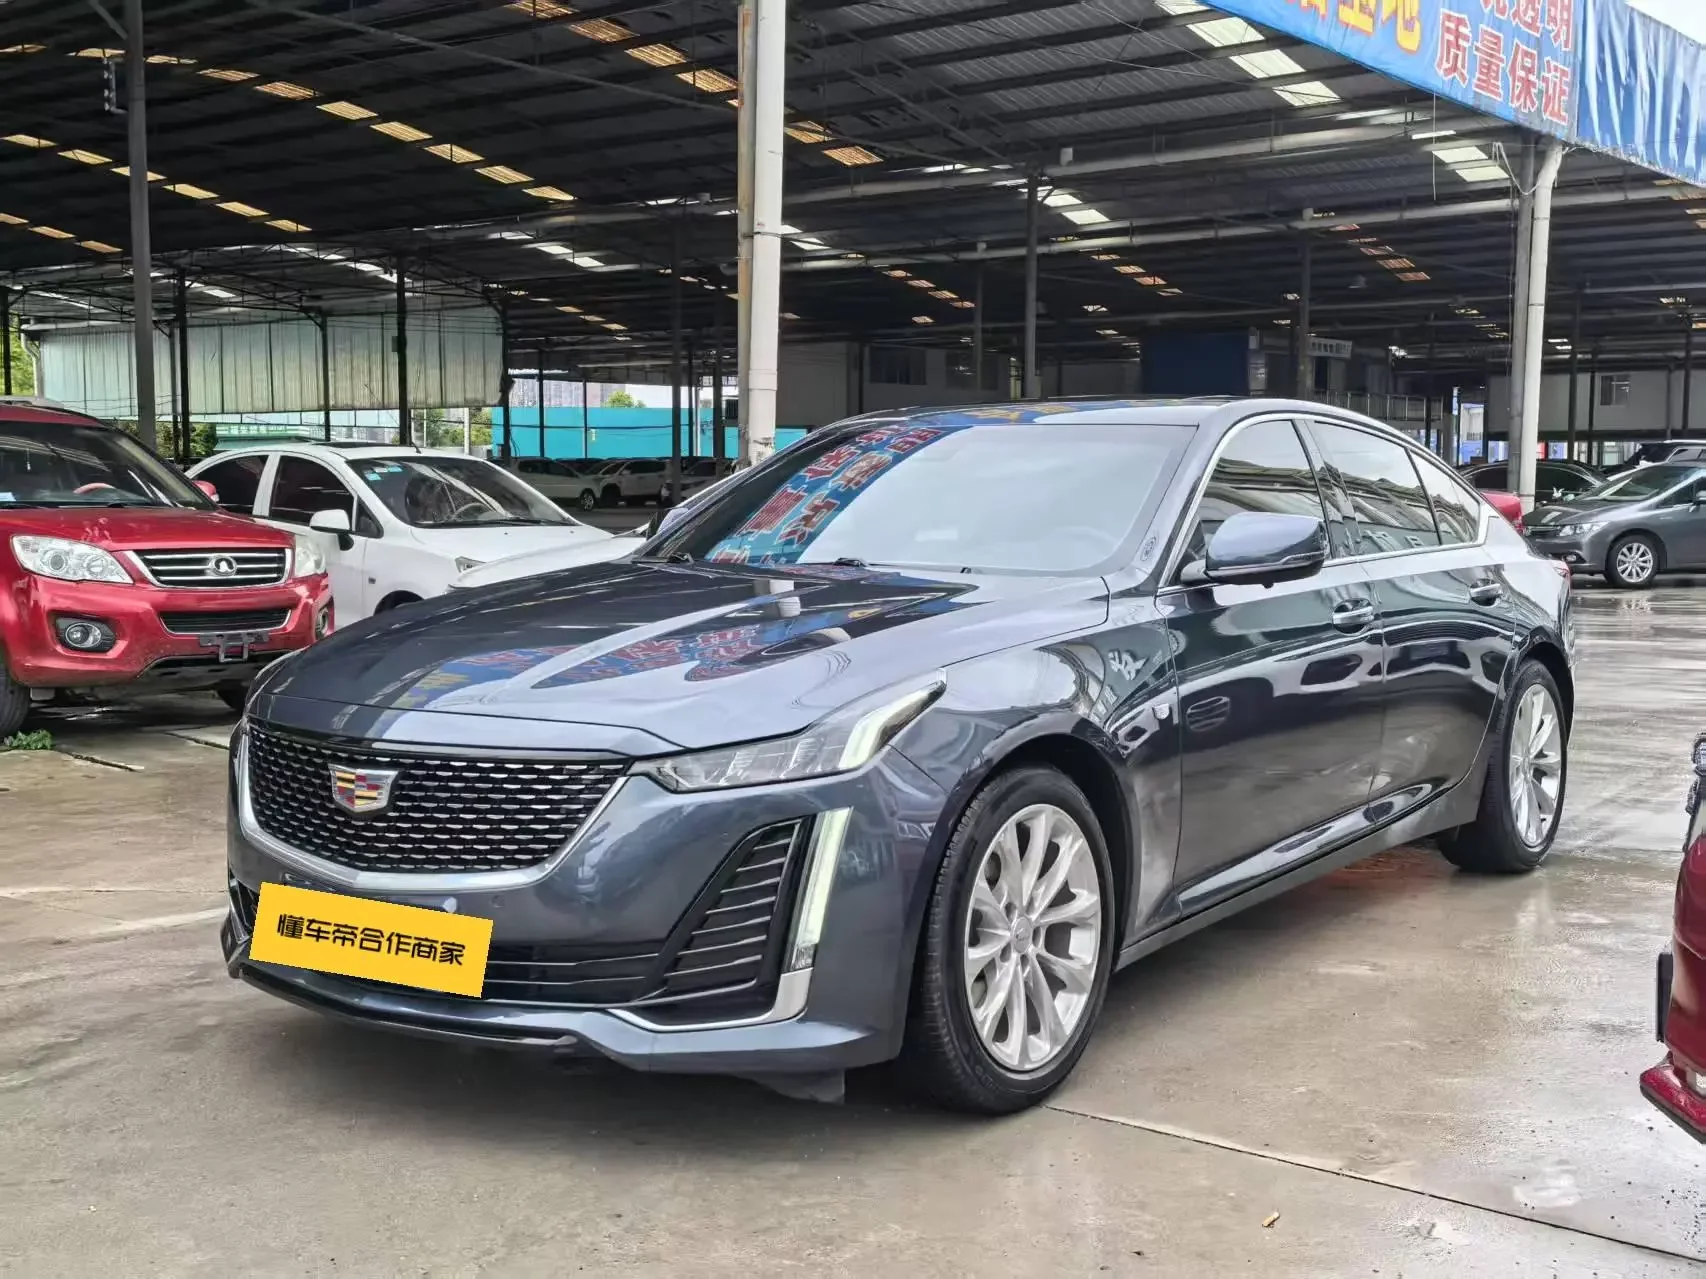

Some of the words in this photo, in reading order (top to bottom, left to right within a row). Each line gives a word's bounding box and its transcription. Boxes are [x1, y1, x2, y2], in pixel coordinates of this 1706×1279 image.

[1435, 8, 1571, 126] 质量保证
[1479, 0, 1574, 51] 透明
